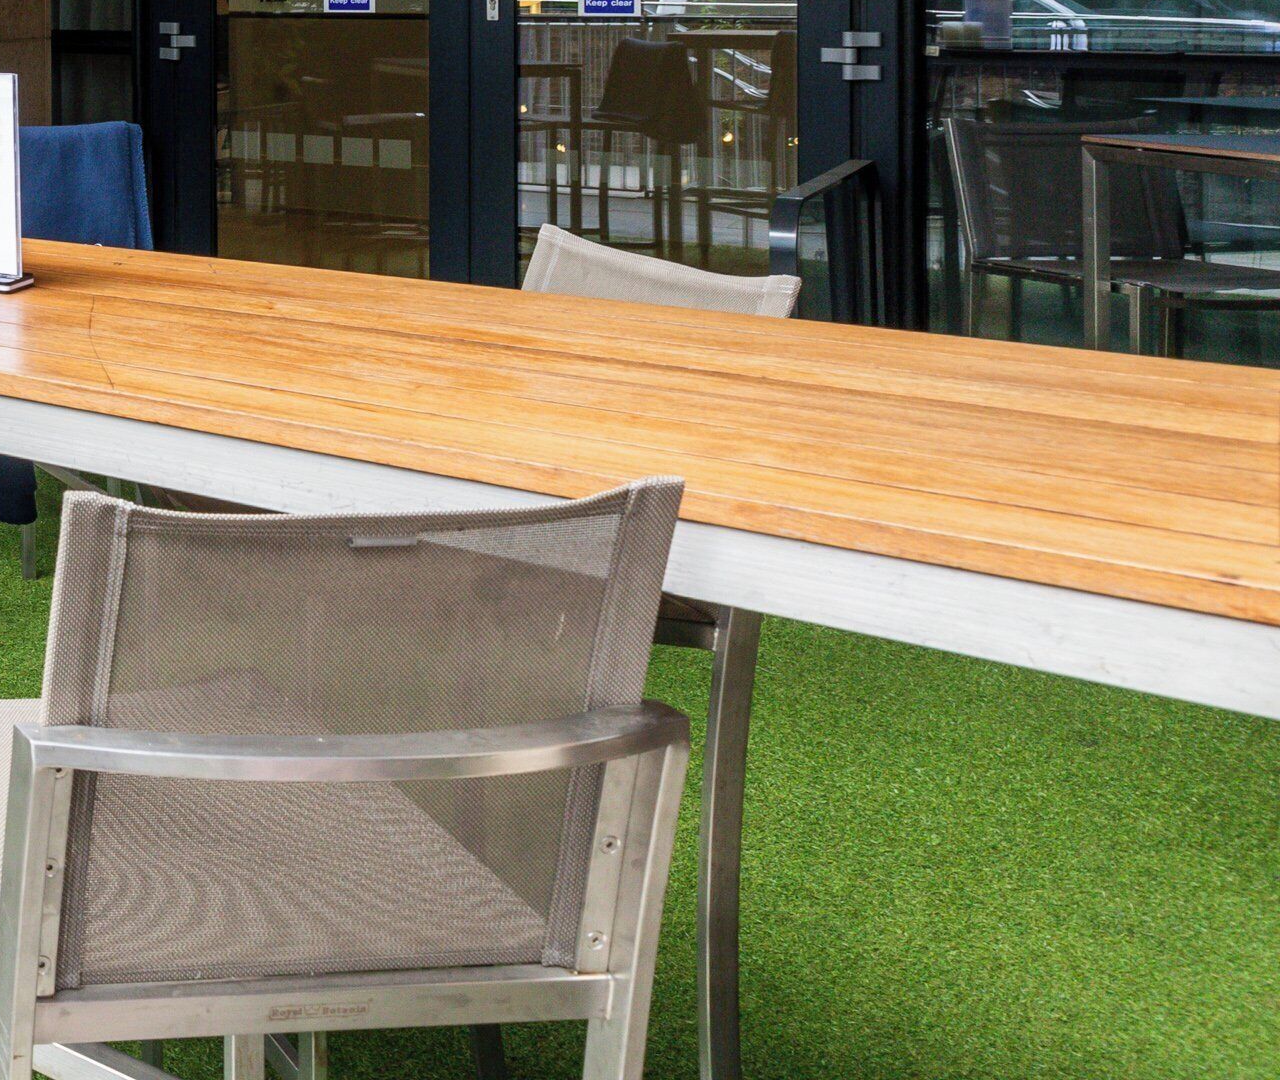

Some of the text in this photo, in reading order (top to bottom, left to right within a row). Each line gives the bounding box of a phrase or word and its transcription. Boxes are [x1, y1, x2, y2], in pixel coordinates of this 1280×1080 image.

[585, 0, 633, 8] Keep clear
[271, 1005, 367, 1019] Royal Botania
